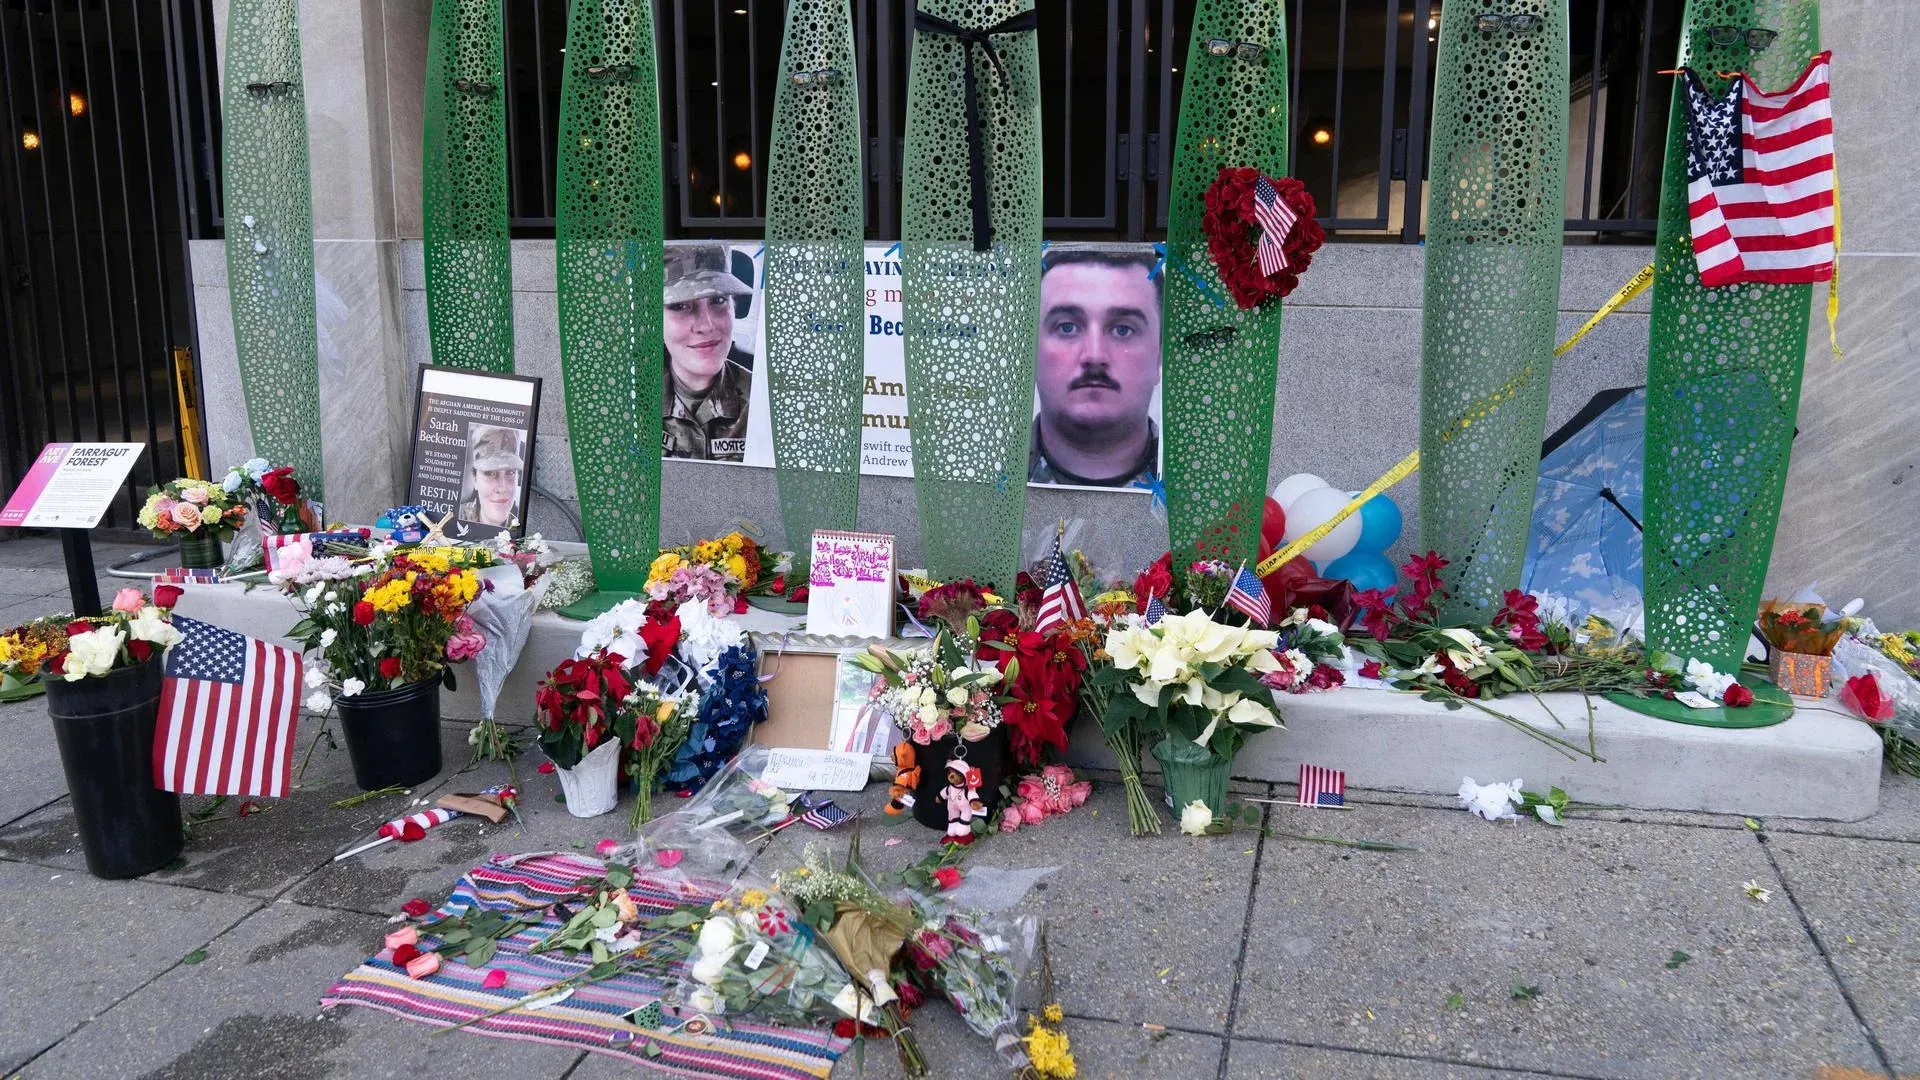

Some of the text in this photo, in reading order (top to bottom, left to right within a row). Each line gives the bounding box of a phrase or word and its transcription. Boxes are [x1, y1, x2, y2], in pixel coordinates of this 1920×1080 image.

[869, 314, 904, 336] Bec
[863, 375, 906, 397] Am
[433, 407, 453, 415] DEEPLY
[453, 409, 482, 418] SADDENED
[501, 416, 516, 424] LOSS
[439, 400, 461, 408] AFGHAN
[461, 403, 491, 413] AMERICAN
[490, 406, 526, 417] COMMUNITY
[430, 417, 459, 432] Sarah
[420, 430, 467, 448] Beckstrom
[72, 448, 130, 457] FARRAGUT
[863, 441, 893, 452] swift
[66, 457, 109, 467] FOREST
[433, 451, 451, 460] STAND
[862, 454, 908, 467] Andrew
[424, 458, 456, 468] SOLIDARITY
[430, 474, 447, 482] LOVED
[433, 466, 444, 474] HER
[444, 469, 462, 477] FAMILY
[420, 485, 459, 501] REST IN
[421, 499, 454, 514] PEACE
